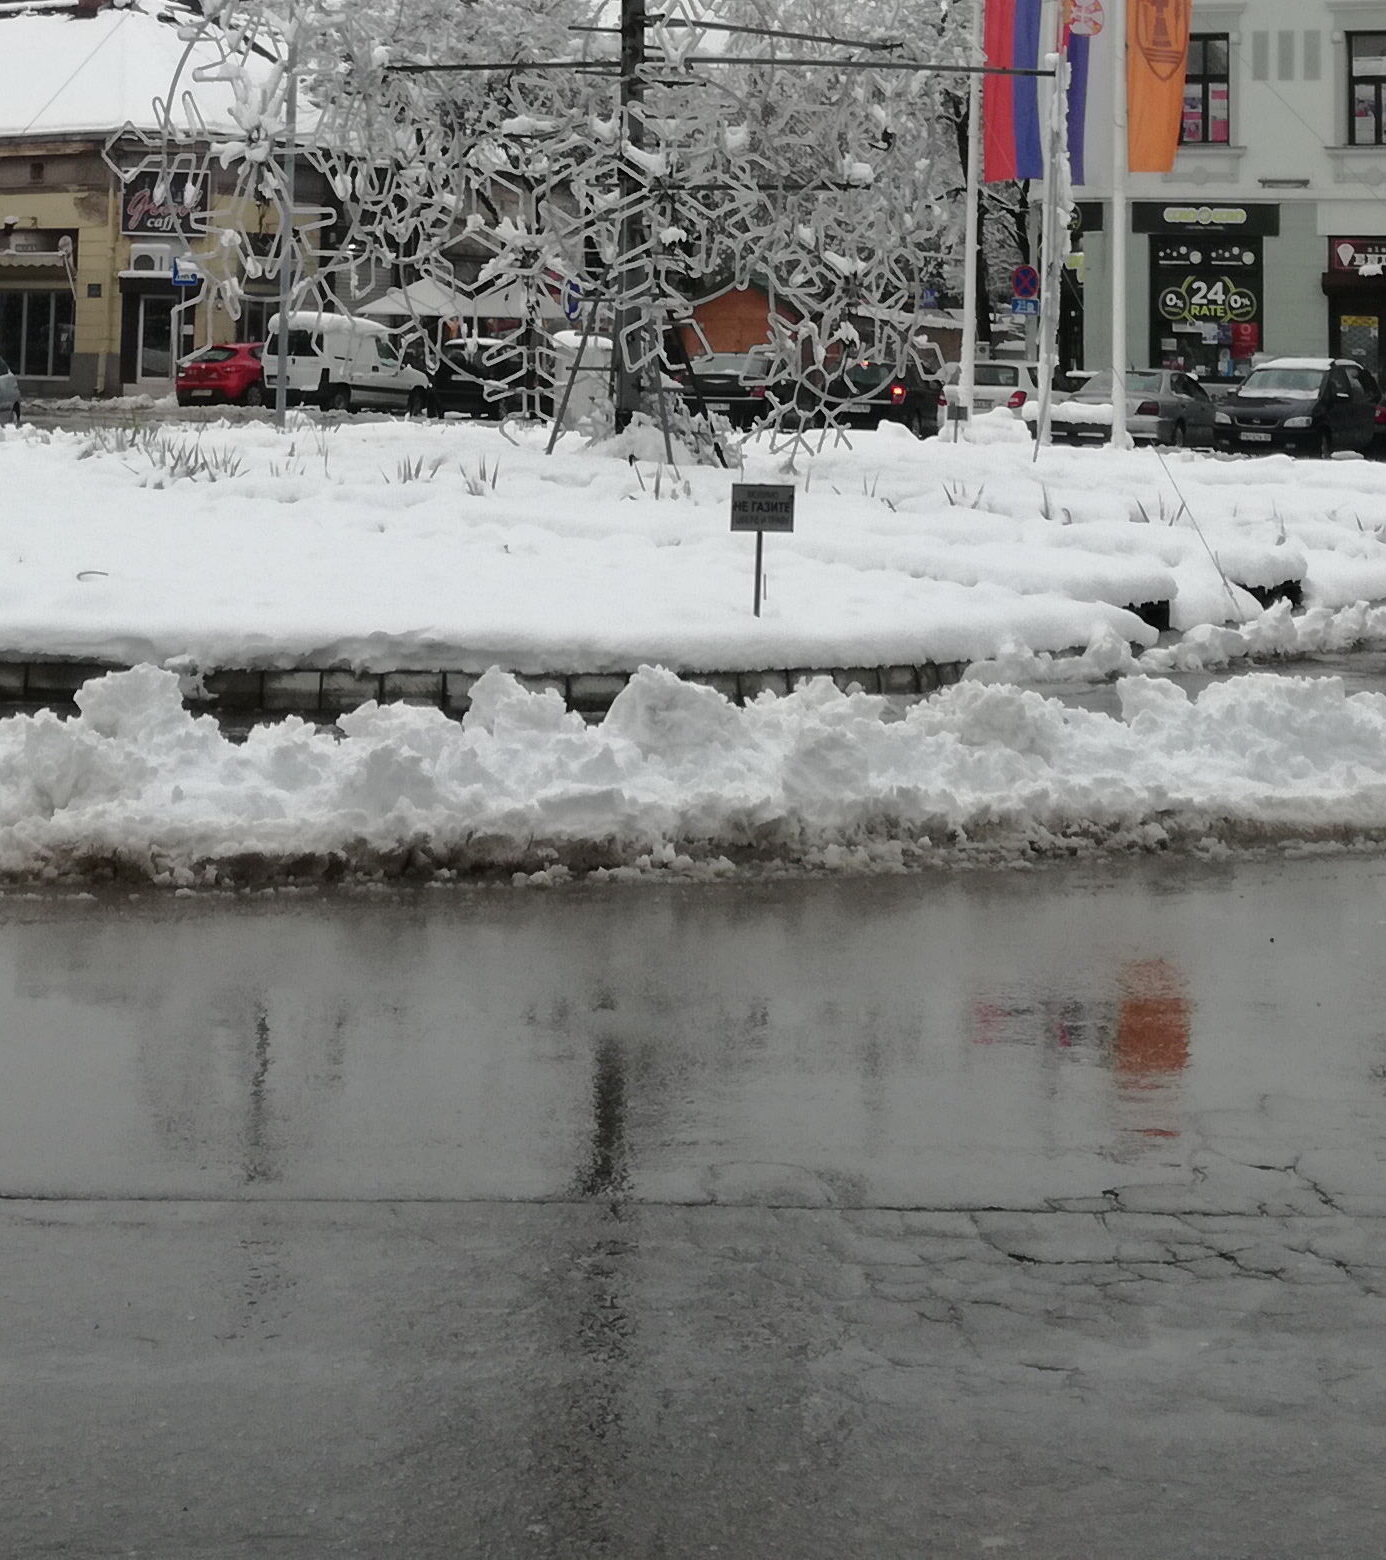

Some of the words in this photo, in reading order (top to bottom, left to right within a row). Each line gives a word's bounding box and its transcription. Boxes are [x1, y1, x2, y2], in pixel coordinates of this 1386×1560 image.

[1191, 281, 1226, 305] 24
[1190, 305, 1226, 317] RATE
[733, 501, 748, 512] НЕ
[751, 501, 790, 513] ГАЗИТЕ
